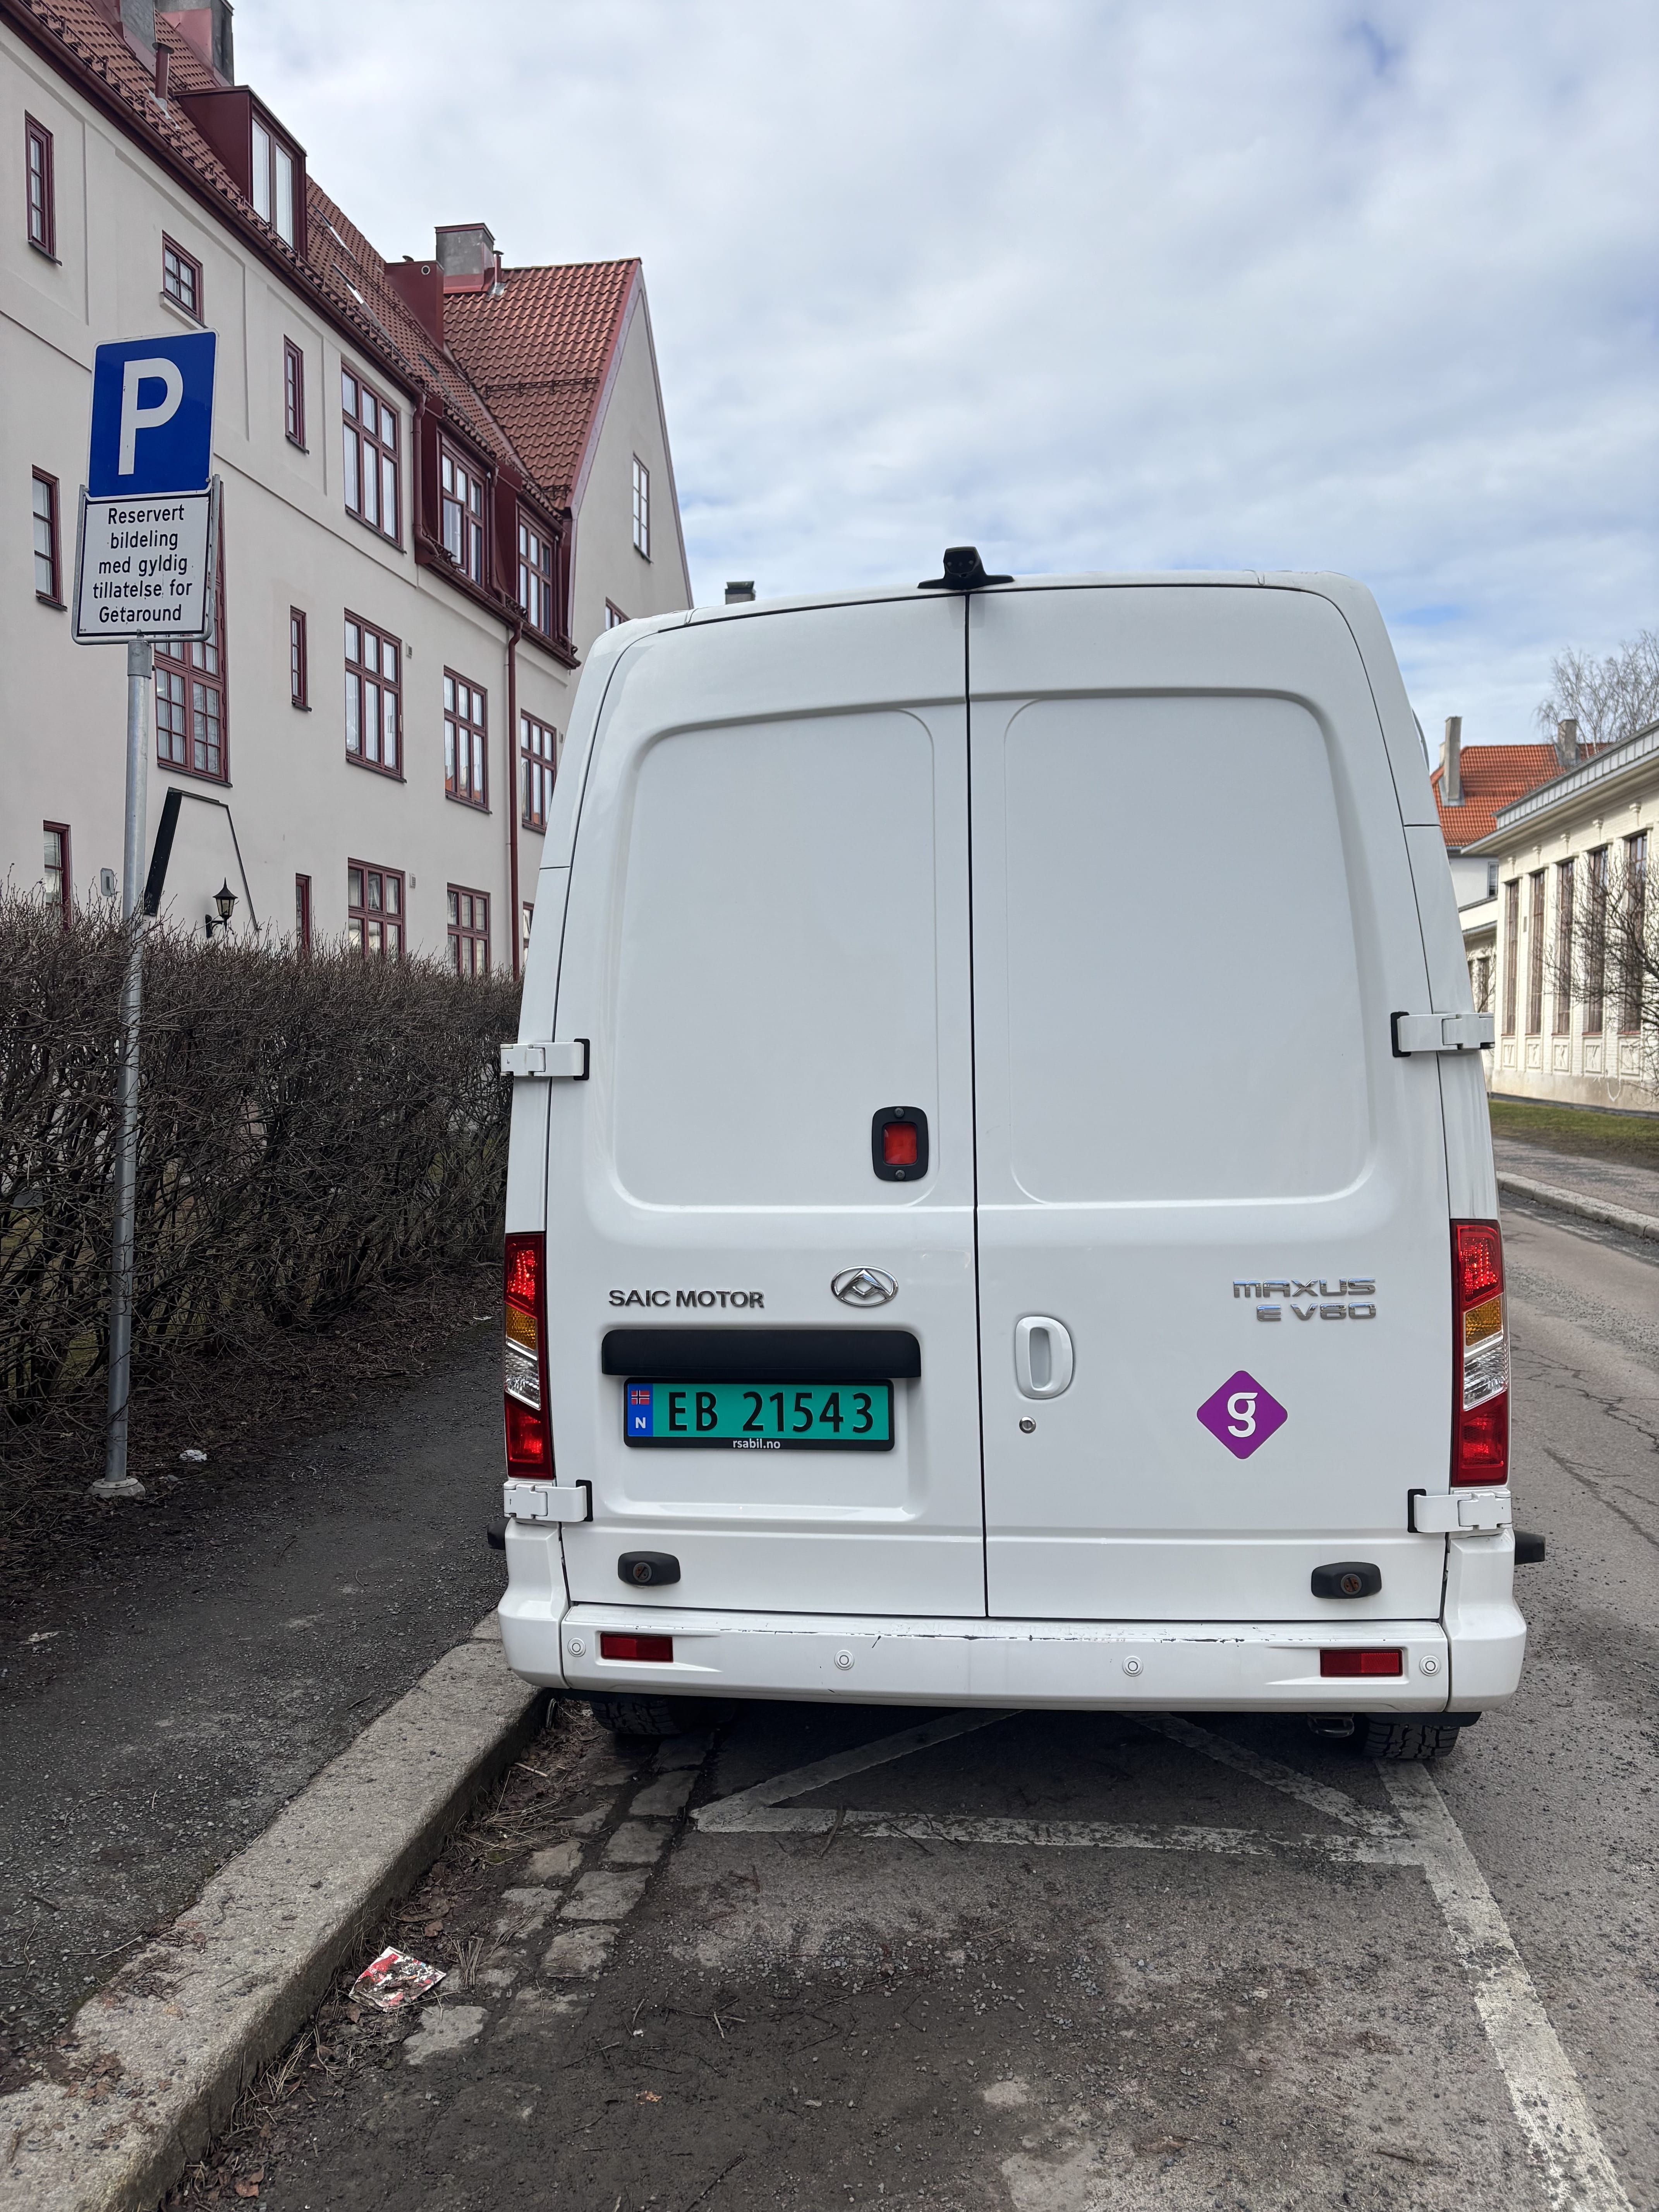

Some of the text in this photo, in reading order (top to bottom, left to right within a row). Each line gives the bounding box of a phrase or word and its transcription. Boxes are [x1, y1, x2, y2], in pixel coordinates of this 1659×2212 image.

[118, 358, 183, 475] P
[108, 504, 185, 524] Reservert
[111, 530, 178, 550] bildeling
[98, 554, 187, 576] med gyldig
[93, 579, 192, 598] tillatelse for
[99, 604, 182, 622] Getaround
[1233, 1278, 1376, 1298] MAXUS
[609, 1290, 764, 1308] SAIC MOTOR
[669, 1391, 873, 1433] EB 21543
[635, 1417, 646, 1429] N
[733, 1438, 781, 1449] rsabil.no
